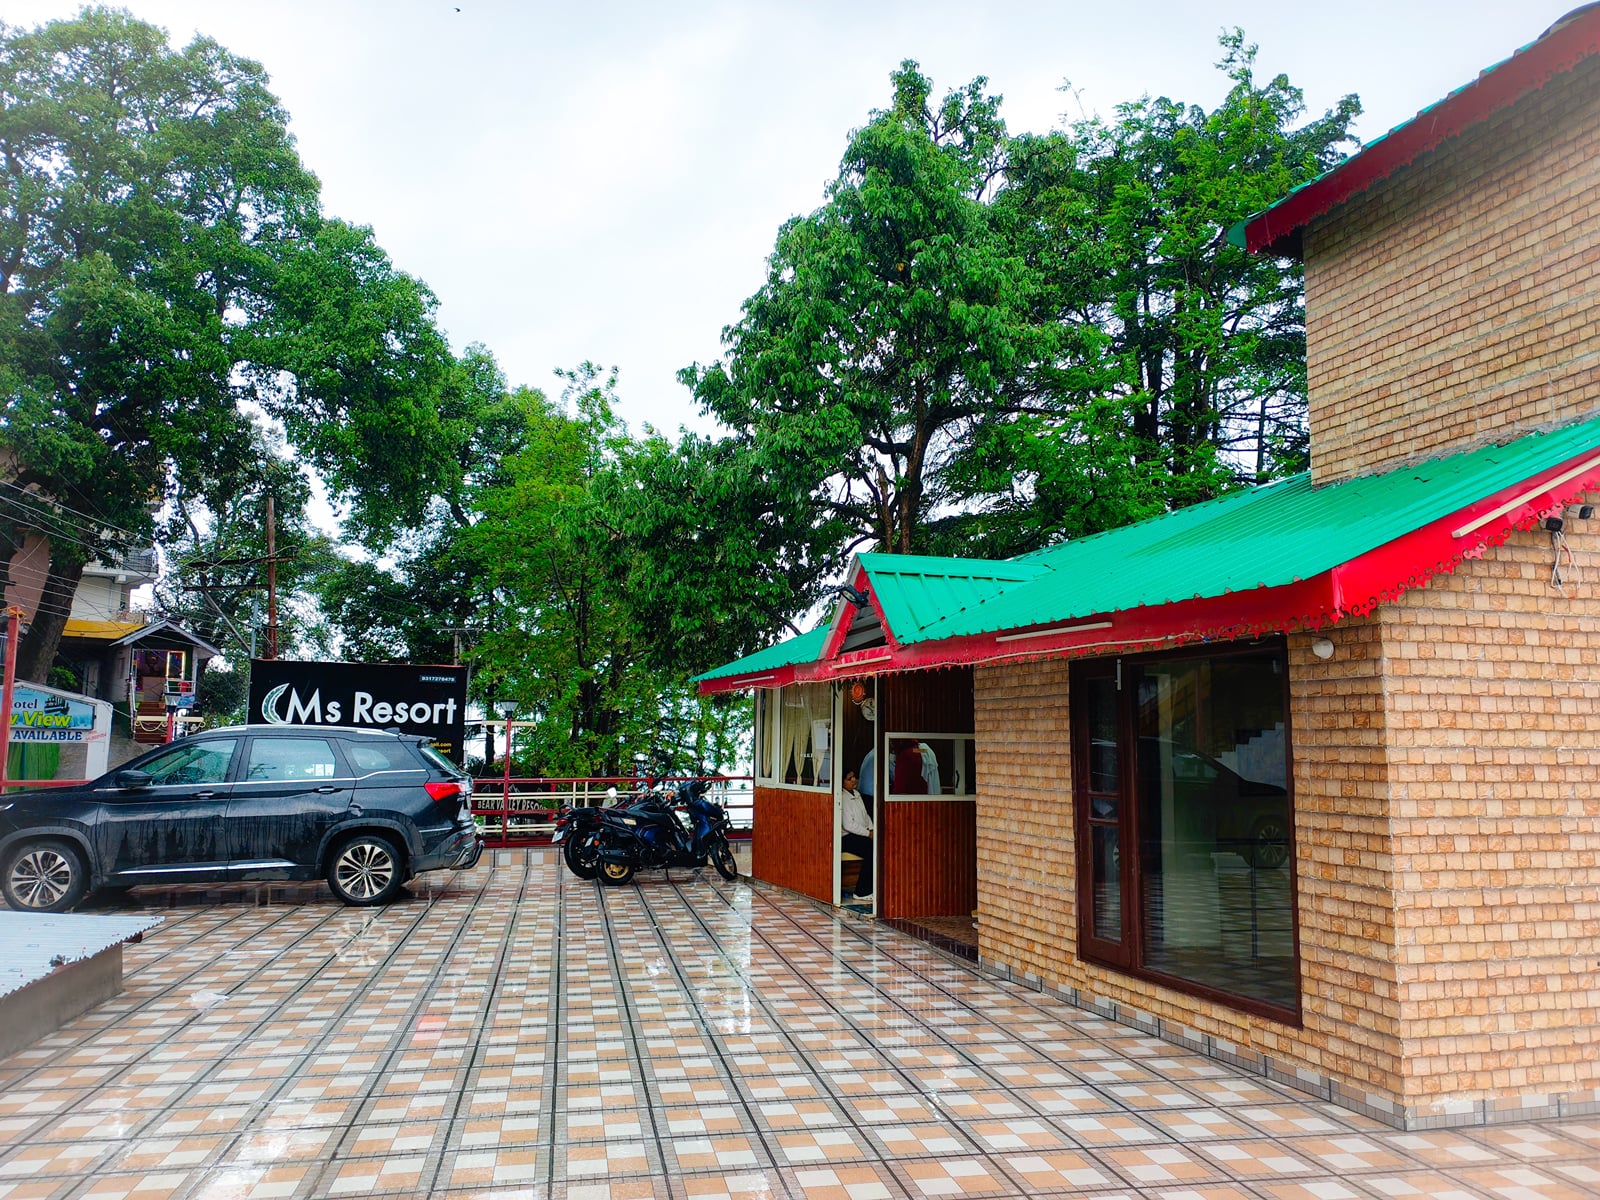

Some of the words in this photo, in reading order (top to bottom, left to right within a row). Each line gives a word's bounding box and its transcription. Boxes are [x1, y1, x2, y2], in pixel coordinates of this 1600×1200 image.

[12, 698, 38, 709] otel
[353, 691, 457, 725] Resort
[23, 710, 72, 727] View
[13, 730, 83, 741] AVAILABLE
[477, 799, 495, 810] BEAR
[496, 799, 521, 811] VALEY
